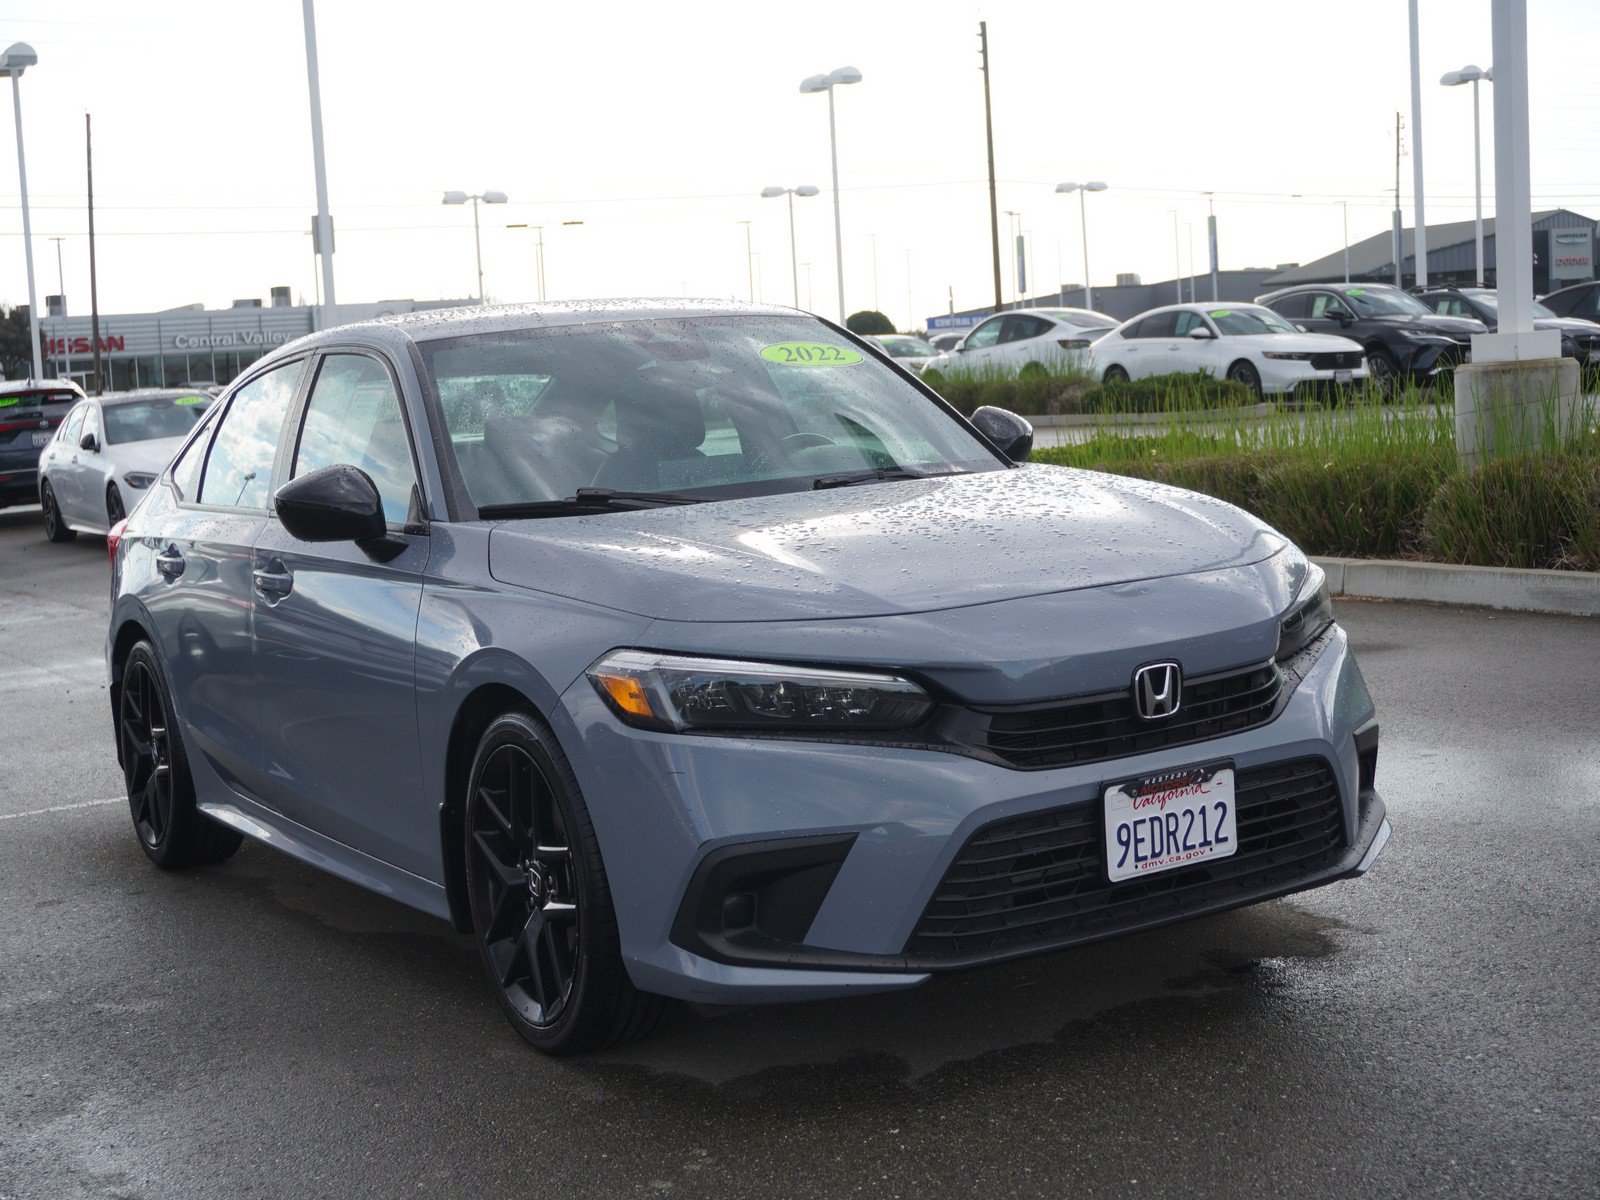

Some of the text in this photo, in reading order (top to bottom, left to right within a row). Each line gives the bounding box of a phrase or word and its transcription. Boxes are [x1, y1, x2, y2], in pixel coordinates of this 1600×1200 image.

[175, 329, 291, 348] Central Valley
[778, 346, 846, 363] 2022
[1144, 771, 1188, 786] WESTERN
[1133, 783, 1211, 811] California
[1116, 801, 1229, 869] 9EDR212
[1141, 849, 1206, 870] dmv.ca.gov
